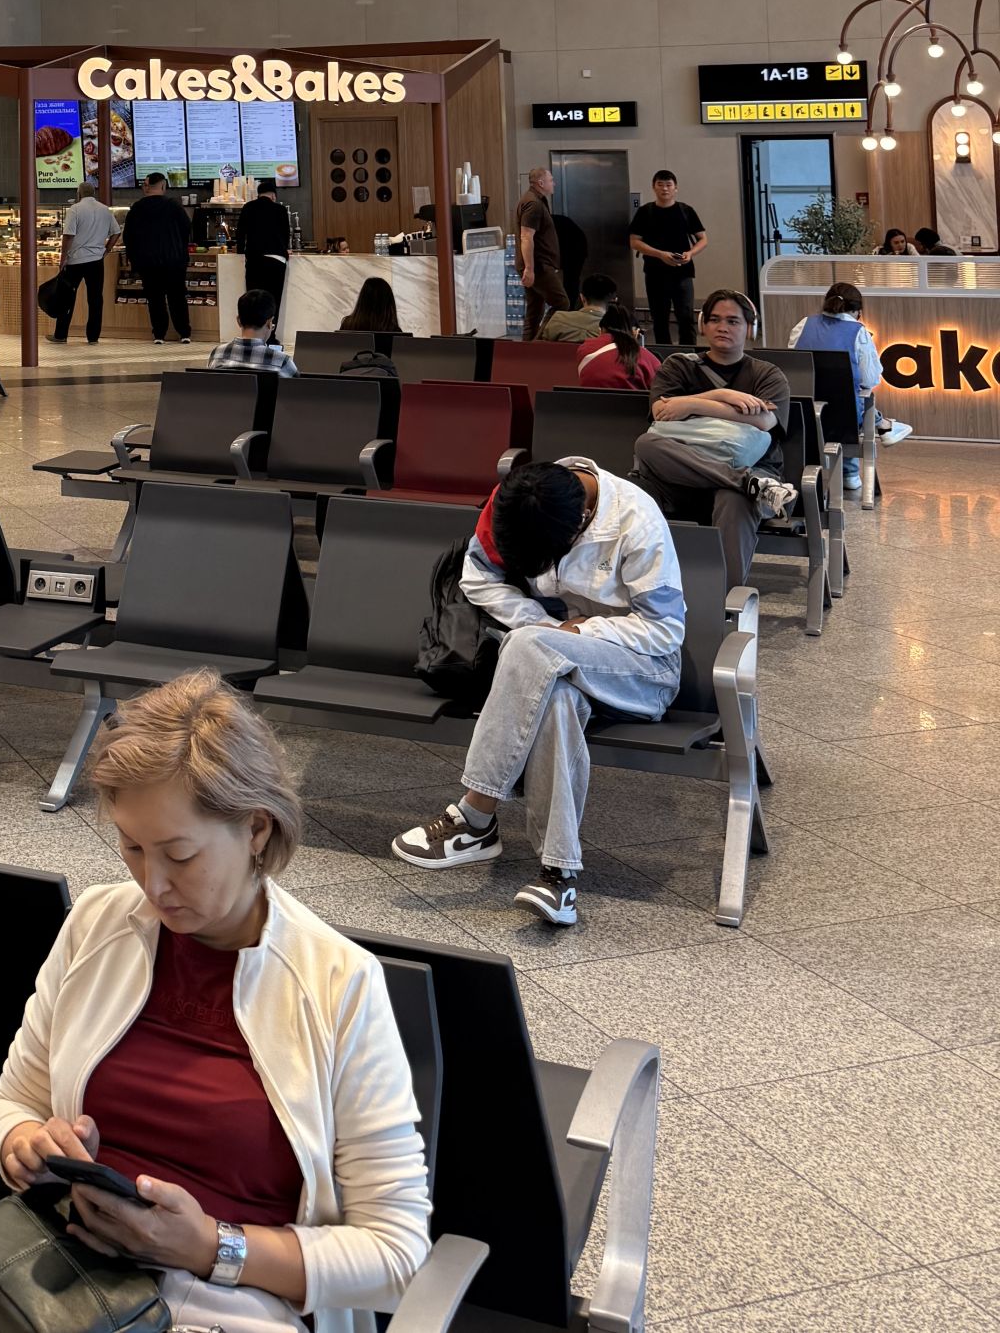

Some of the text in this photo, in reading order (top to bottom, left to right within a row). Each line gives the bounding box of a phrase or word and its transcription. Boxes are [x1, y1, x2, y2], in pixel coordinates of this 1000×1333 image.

[77, 54, 406, 103] Cakes&Bakes
[760, 67, 809, 81] 1A-1B
[547, 110, 584, 121] 1A-1B
